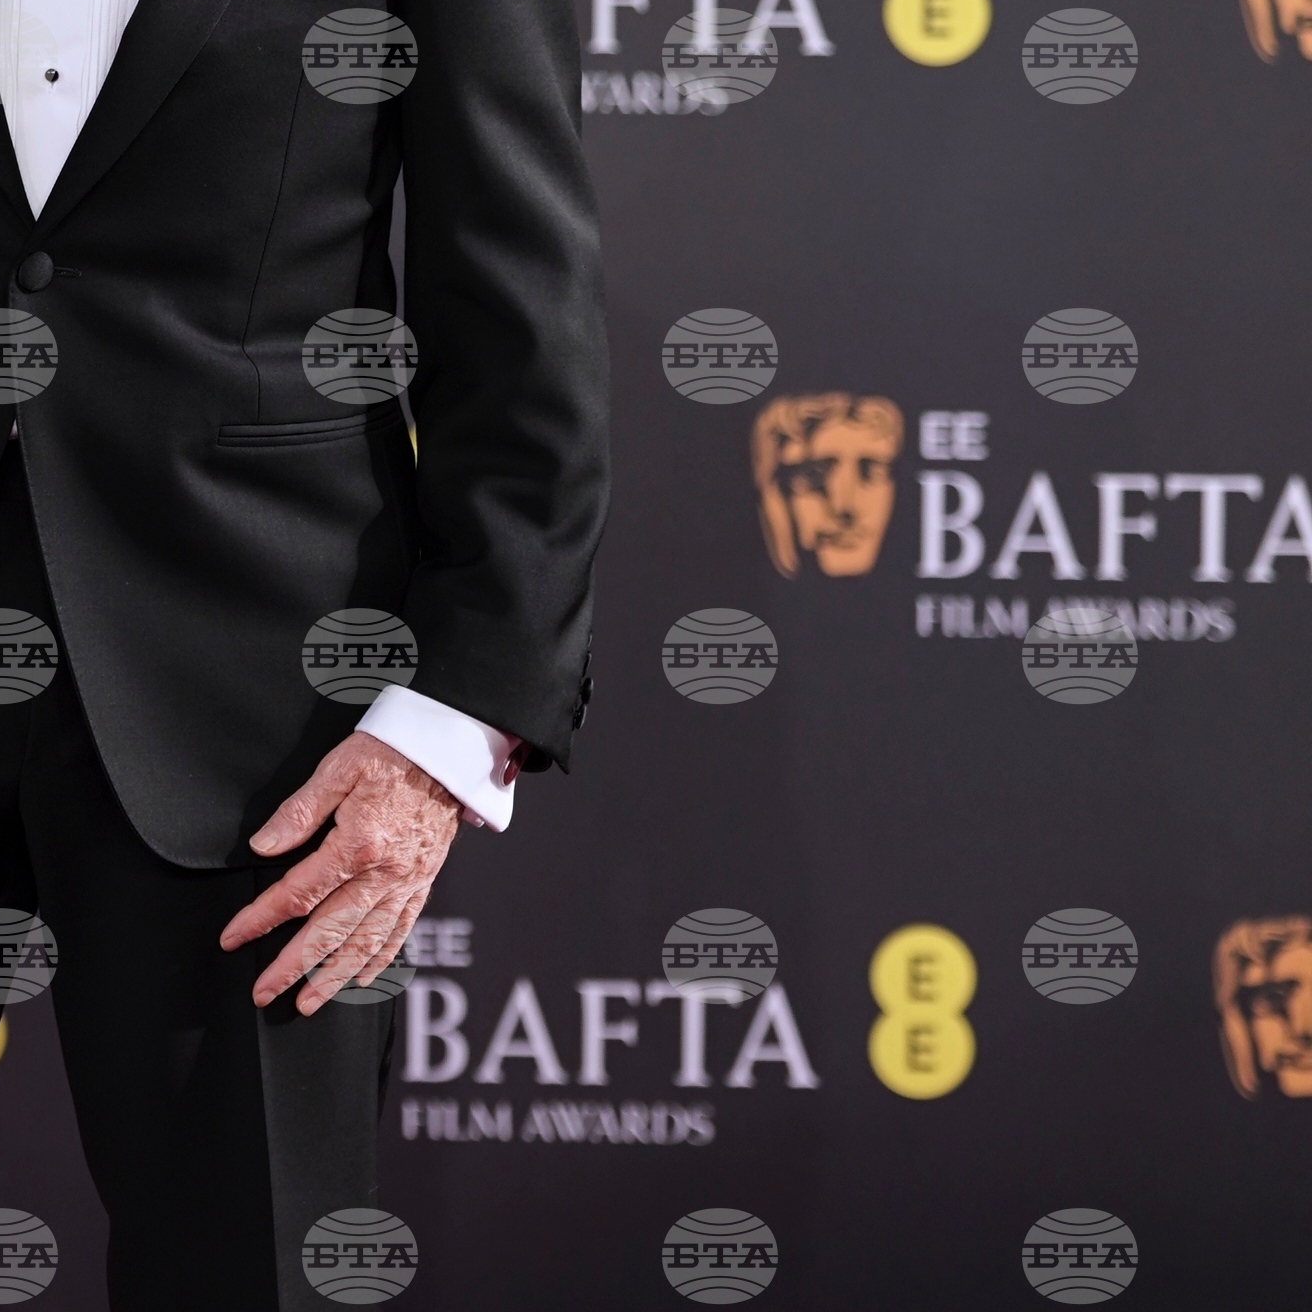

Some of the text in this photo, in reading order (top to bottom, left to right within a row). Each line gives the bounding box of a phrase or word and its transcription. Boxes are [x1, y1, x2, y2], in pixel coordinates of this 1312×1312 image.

[919, 410, 990, 461] EE
[915, 595, 1238, 643] FILM AWARDS
[401, 978, 821, 1090] BAFTA
[401, 1098, 718, 1147] FILM AWARDS
